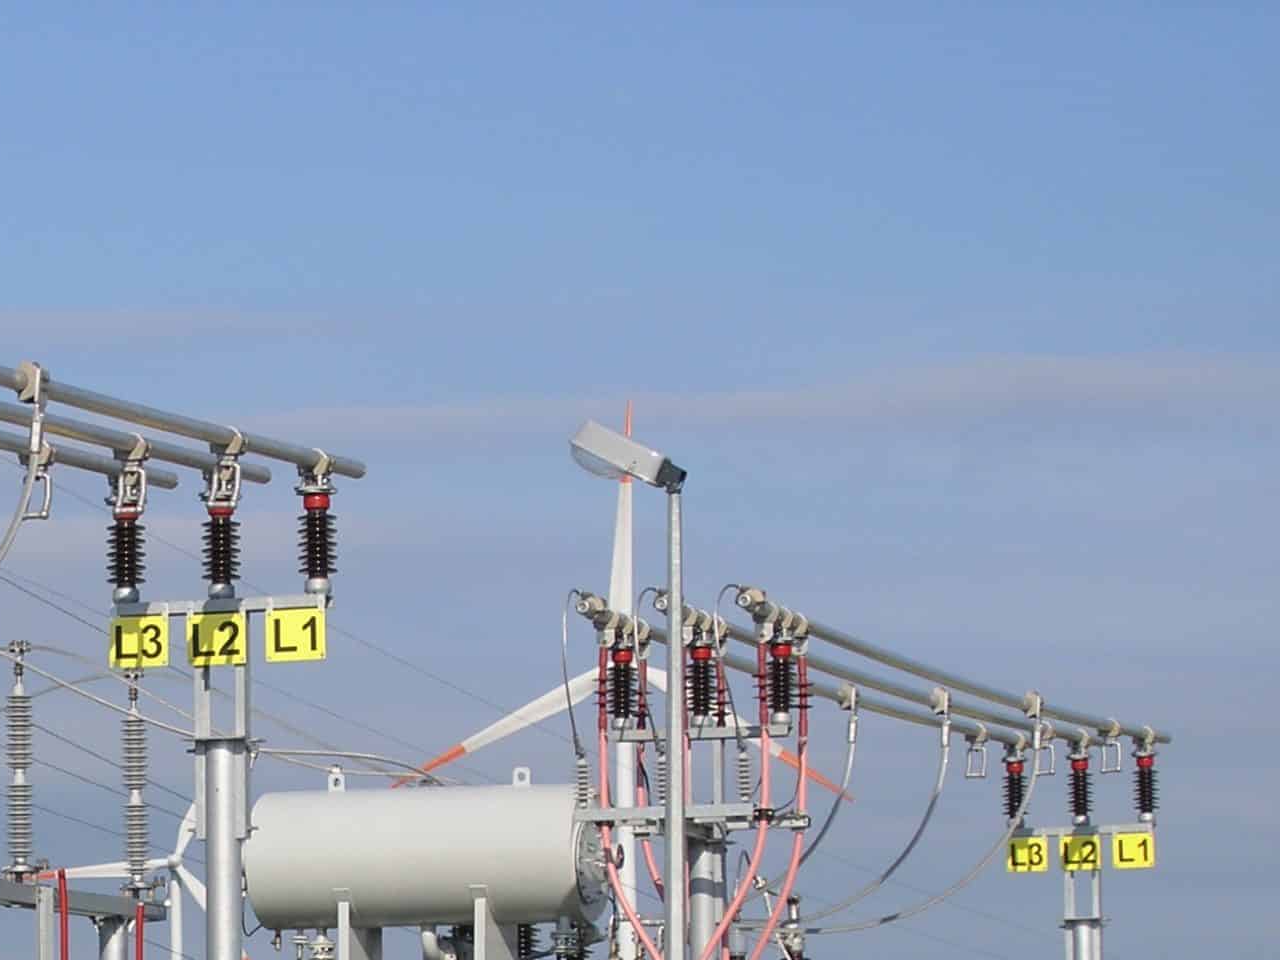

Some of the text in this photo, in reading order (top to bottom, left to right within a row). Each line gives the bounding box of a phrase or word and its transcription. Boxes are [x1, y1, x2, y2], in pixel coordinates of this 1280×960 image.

[115, 623, 163, 660] L3
[192, 620, 241, 658] L2
[273, 616, 318, 653] L1
[1010, 842, 1043, 867] L3
[1063, 841, 1097, 865] L2
[1118, 839, 1148, 863] L1
